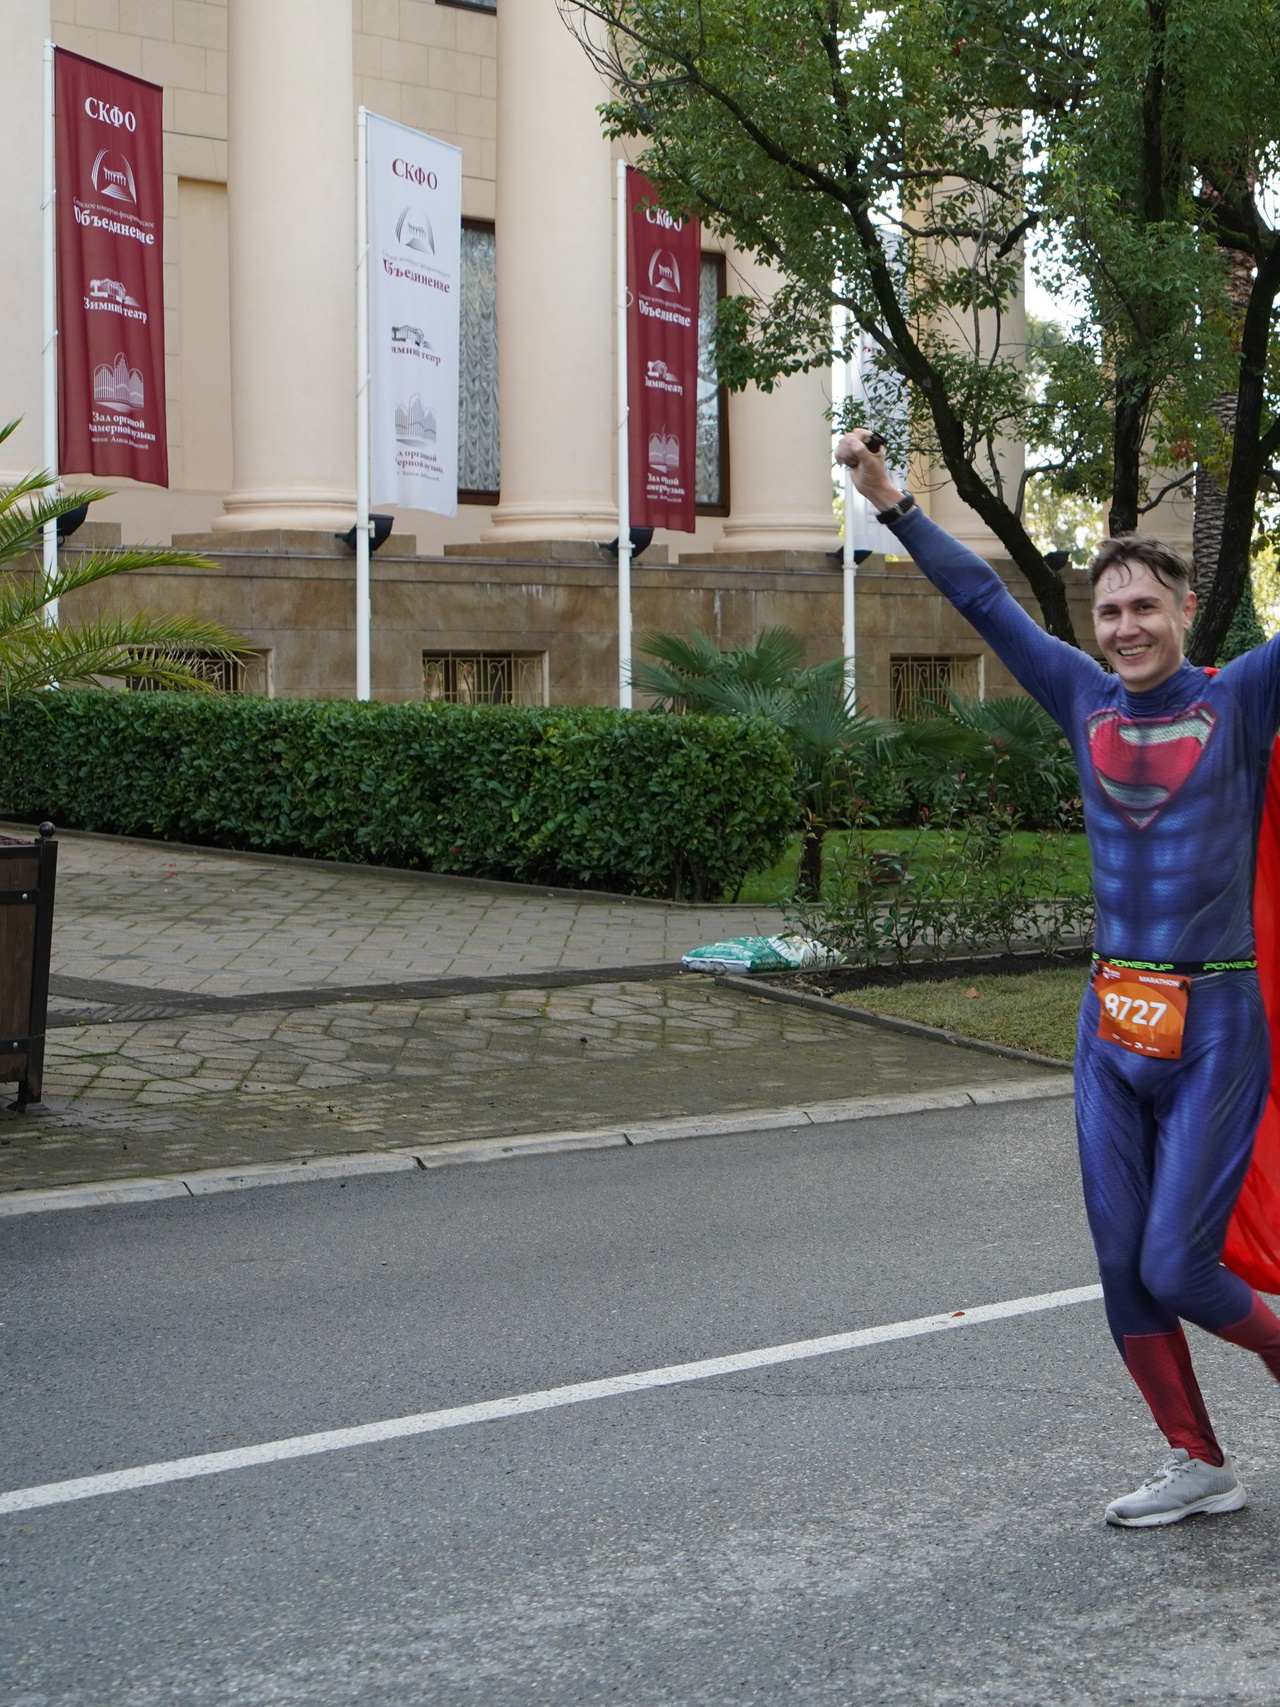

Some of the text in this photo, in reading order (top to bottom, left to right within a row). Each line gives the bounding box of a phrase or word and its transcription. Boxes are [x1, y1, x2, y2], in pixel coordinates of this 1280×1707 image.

[84, 97, 136, 133] СКФО
[392, 158, 438, 190] СКФО
[123, 307, 147, 324] театр
[92, 411, 111, 422] Зал
[1109, 958, 1174, 971] POWERUP
[1203, 960, 1257, 971] POWERU
[1138, 975, 1180, 987] MARATHON
[1104, 992, 1167, 1027] 8727
